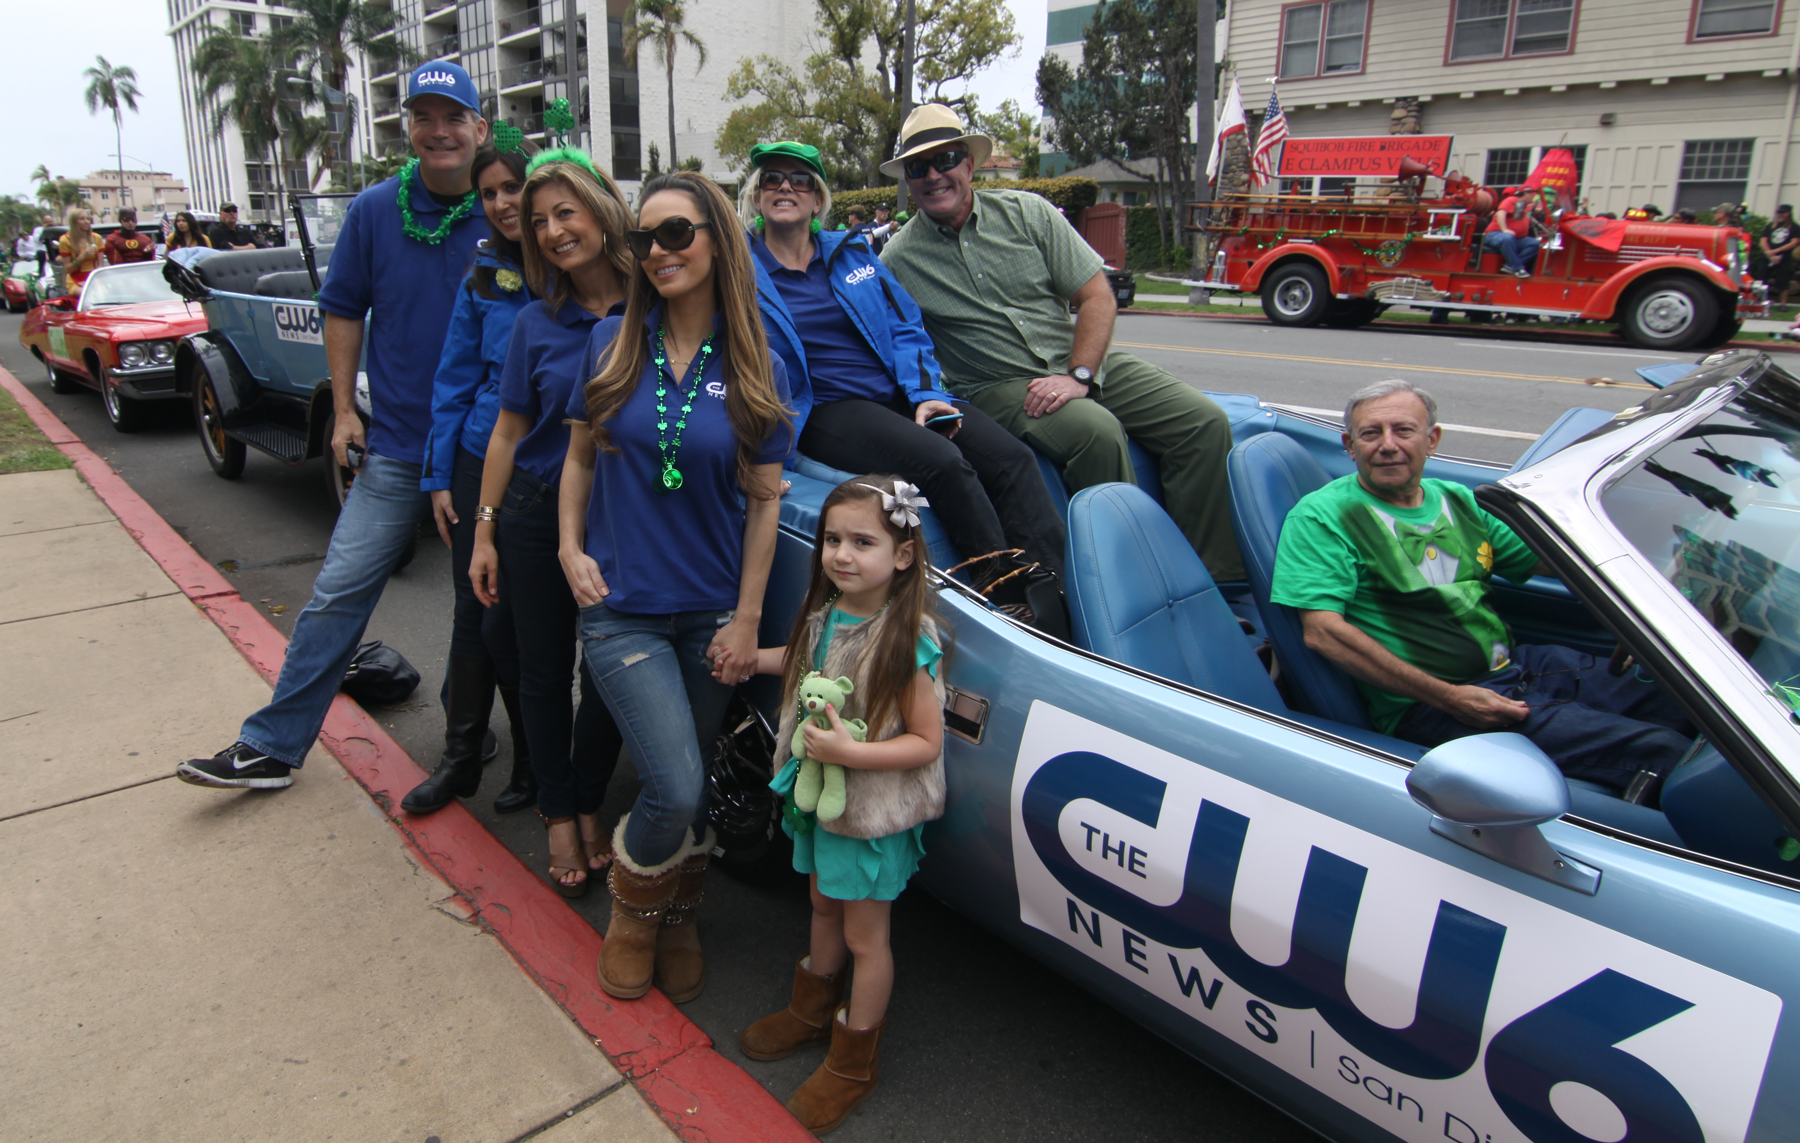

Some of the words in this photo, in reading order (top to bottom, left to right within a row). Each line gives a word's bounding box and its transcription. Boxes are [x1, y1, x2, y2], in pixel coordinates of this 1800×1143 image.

[417, 71, 456, 85] CW6
[1290, 141, 1345, 153] SQUIBOB
[1347, 141, 1376, 152] FIRE
[1379, 140, 1442, 151] BRIGADE
[1284, 158, 1295, 171] E
[1298, 157, 1382, 171] CLAMPUS
[845, 263, 875, 283] CW6
[274, 306, 321, 334] CW6
[281, 330, 299, 340] NEWS
[708, 391, 726, 400] NEW
[1080, 821, 1148, 879] THE
[1022, 751, 1707, 1143] CW6
[1066, 897, 1279, 1044] NEWS
[1337, 1055, 1424, 1123] San
